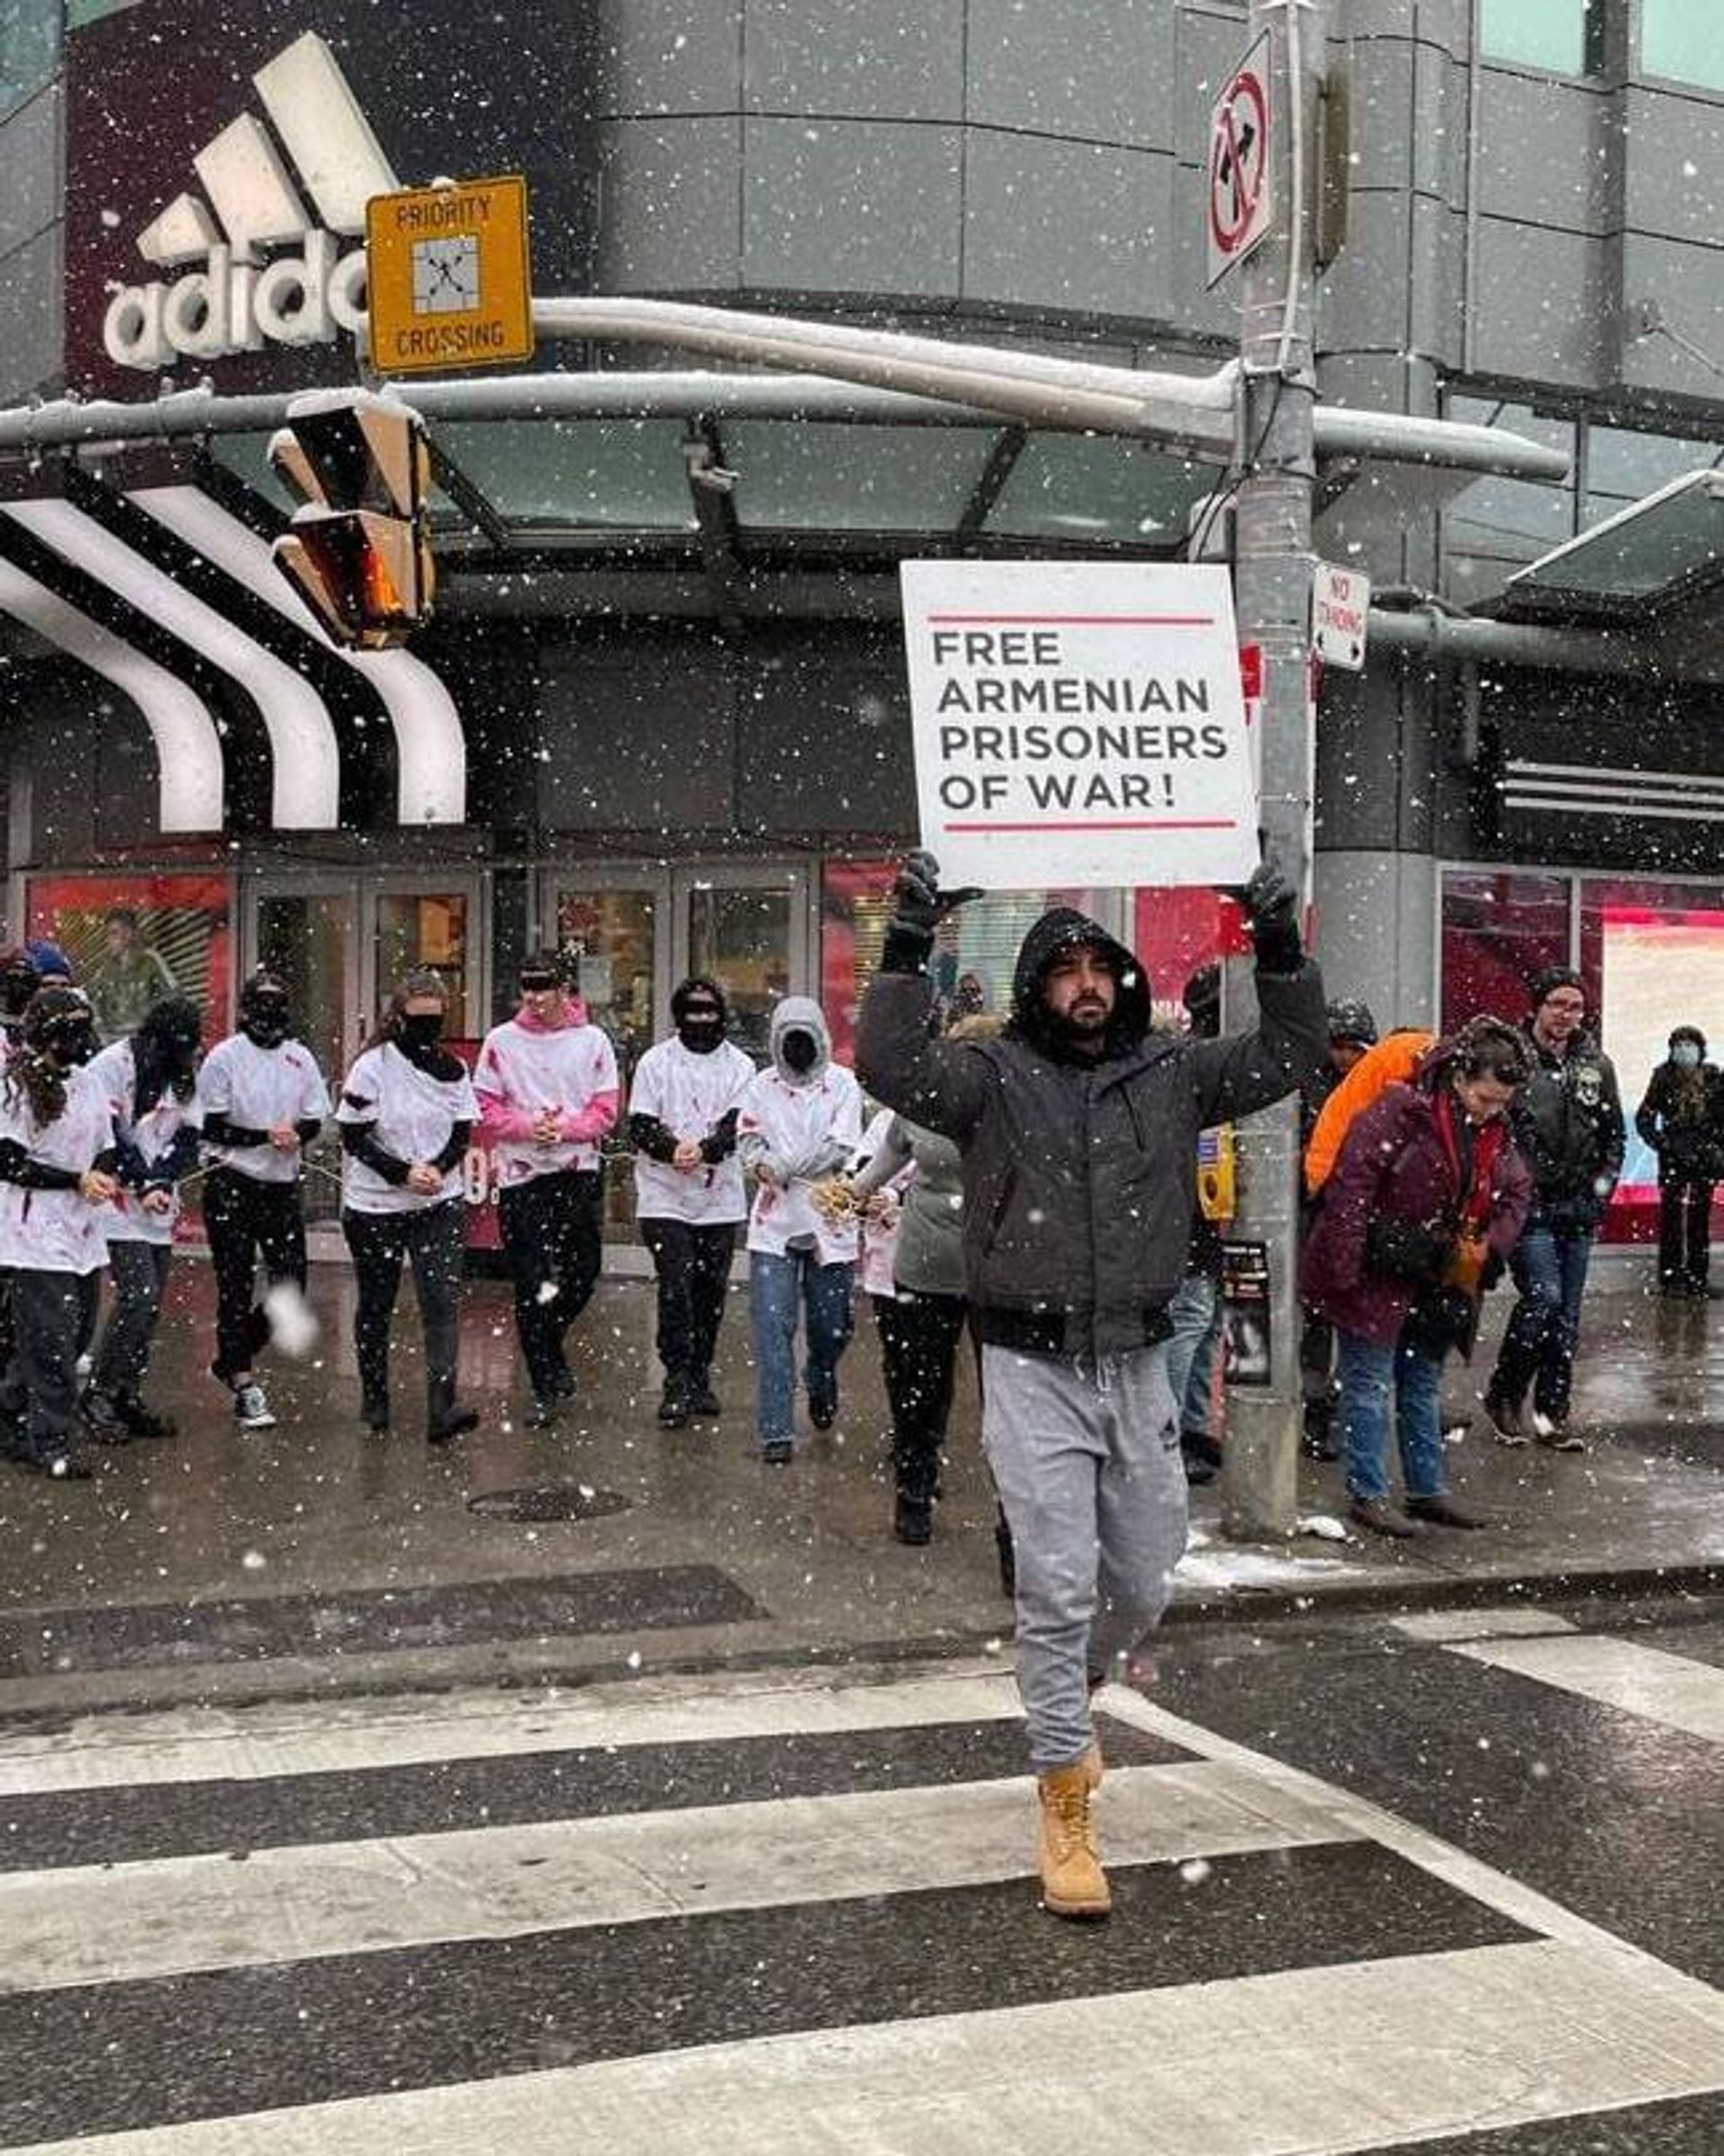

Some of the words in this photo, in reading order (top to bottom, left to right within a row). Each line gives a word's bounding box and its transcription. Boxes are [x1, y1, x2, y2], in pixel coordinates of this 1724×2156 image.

[397, 196, 492, 230] PRIORITY
[103, 229, 371, 371] adid
[397, 321, 505, 356] CROSSING
[1331, 576, 1349, 602] NO
[933, 631, 1060, 665] FREE
[937, 679, 1209, 714] ARMENIAN
[940, 726, 1228, 761] PRISONERS
[939, 774, 1008, 810] OF
[1026, 772, 1174, 810] WAR!
